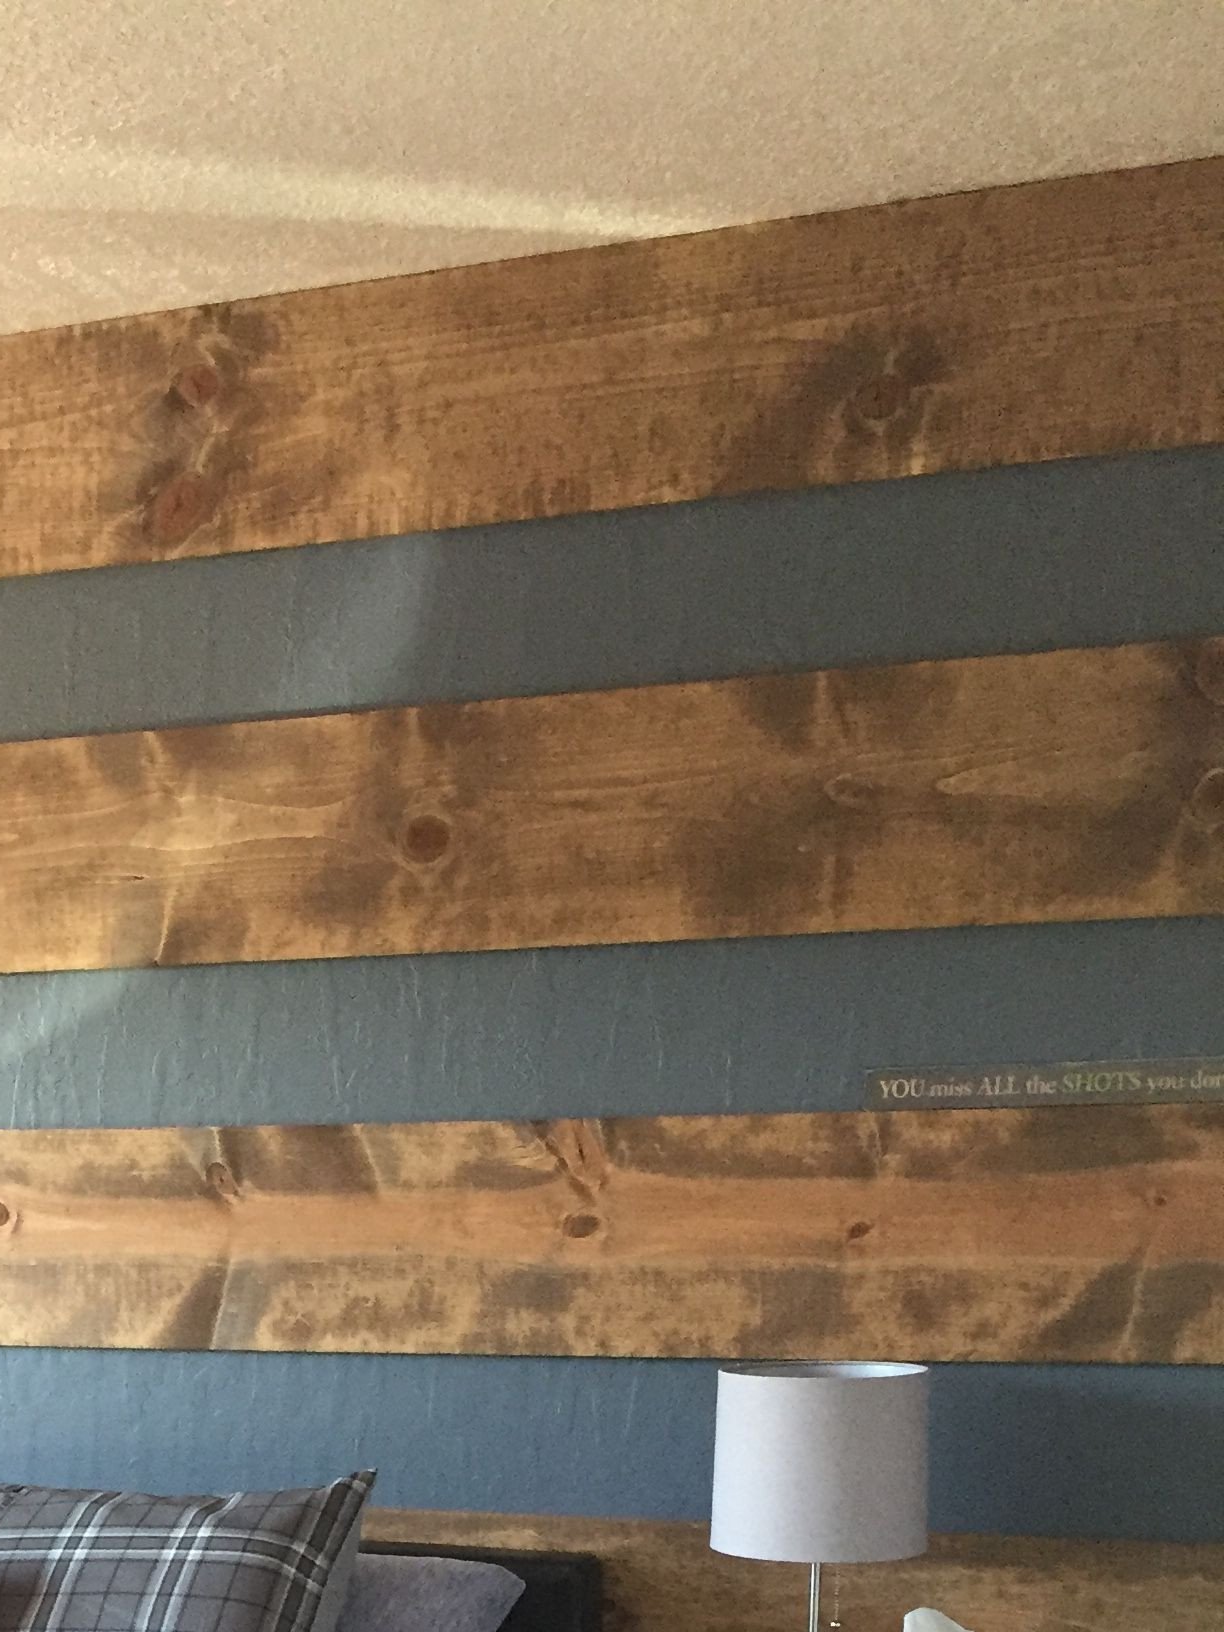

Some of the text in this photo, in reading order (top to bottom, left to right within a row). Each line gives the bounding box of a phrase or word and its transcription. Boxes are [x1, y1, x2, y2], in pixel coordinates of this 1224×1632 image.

[880, 1079, 925, 1098] YOU
[929, 1077, 972, 1097] miss
[977, 1076, 1020, 1096] ALL
[1026, 1075, 1056, 1094] the
[1063, 1072, 1141, 1093] SHOTS
[1147, 1076, 1184, 1094] you
